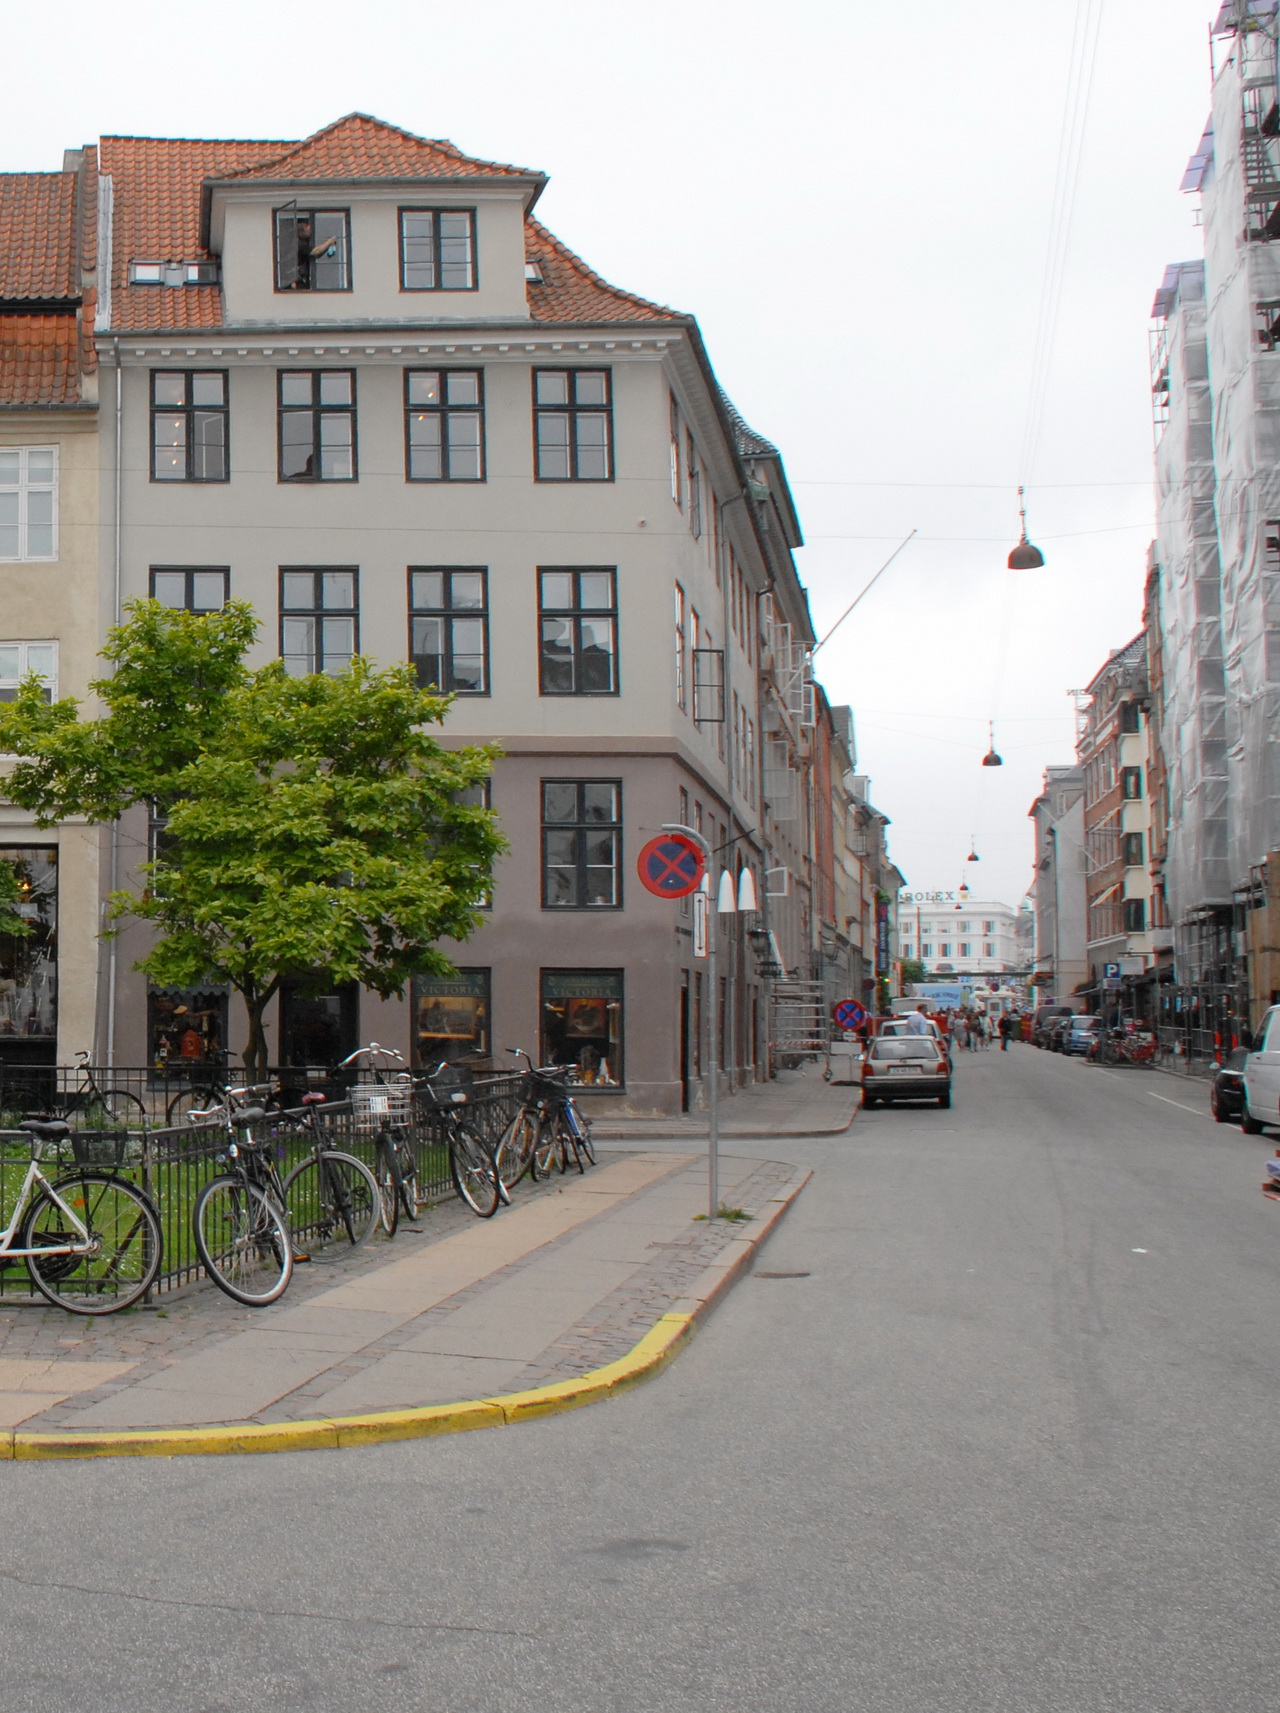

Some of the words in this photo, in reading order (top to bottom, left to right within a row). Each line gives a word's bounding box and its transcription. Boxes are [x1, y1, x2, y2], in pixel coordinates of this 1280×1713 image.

[904, 891, 955, 901] ROLEX
[1106, 964, 1118, 977] P
[420, 986, 480, 994] VICTORIA
[551, 988, 611, 996] VICTORIA
